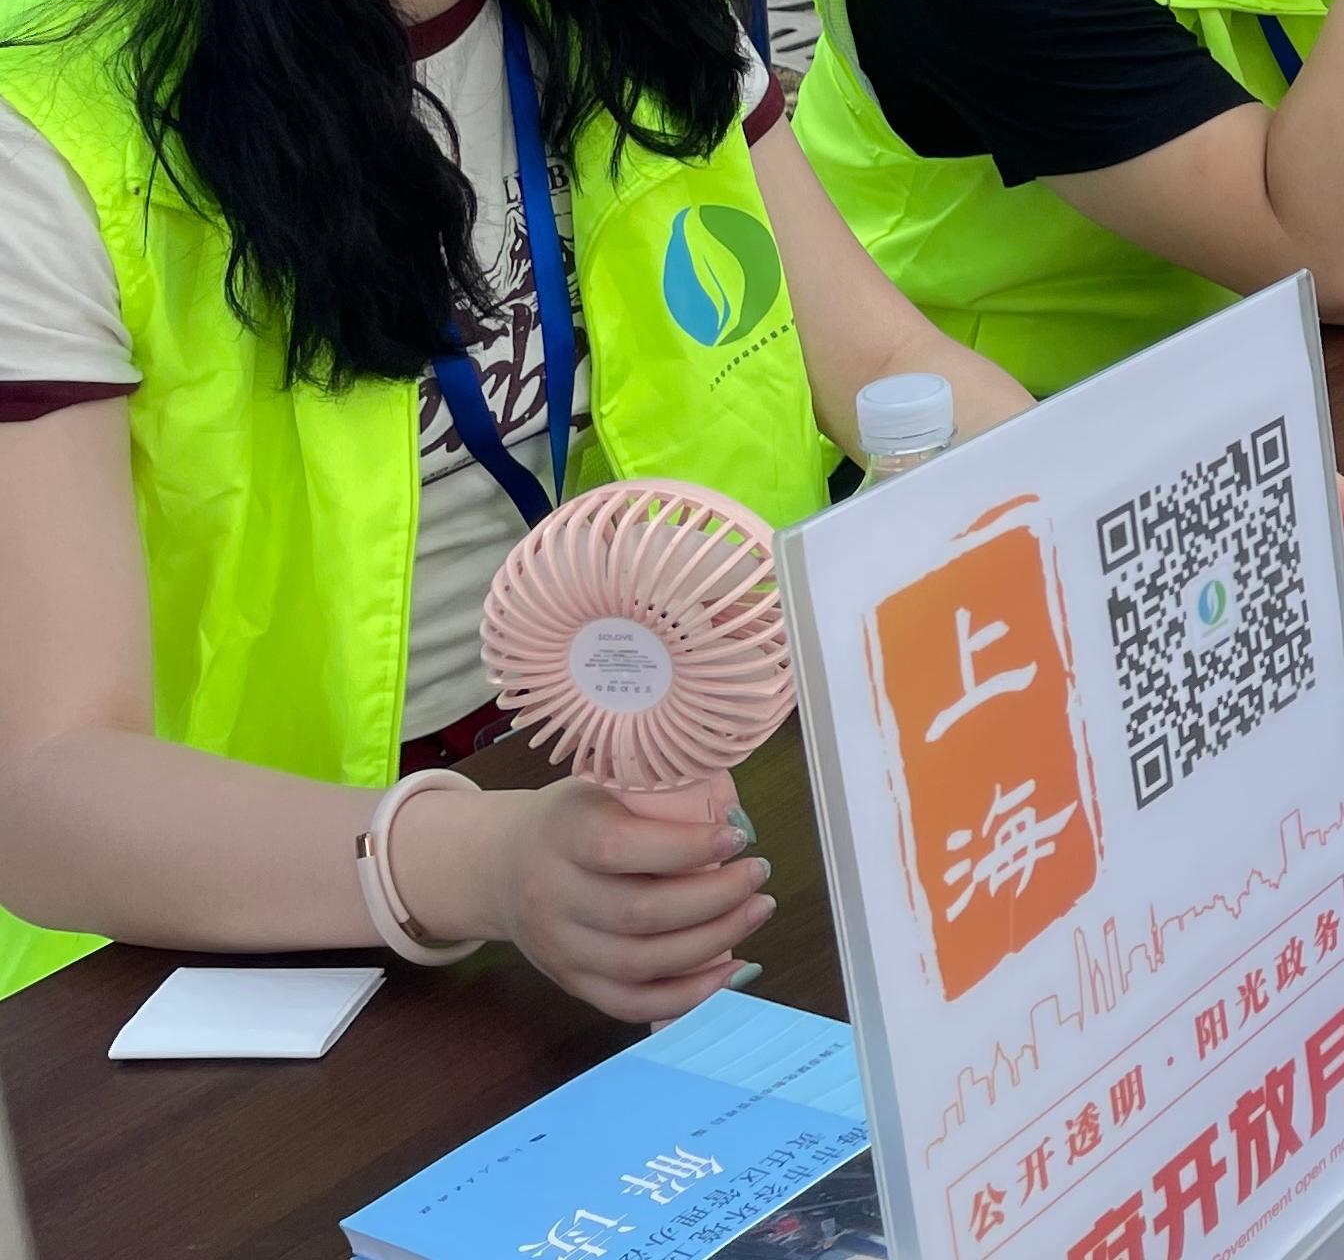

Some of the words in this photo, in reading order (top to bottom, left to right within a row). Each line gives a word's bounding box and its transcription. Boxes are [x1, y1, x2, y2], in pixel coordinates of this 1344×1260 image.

[925, 606, 1079, 923] 上海
[518, 1144, 725, 1260] 解读
[1293, 1156, 1328, 1196] open
